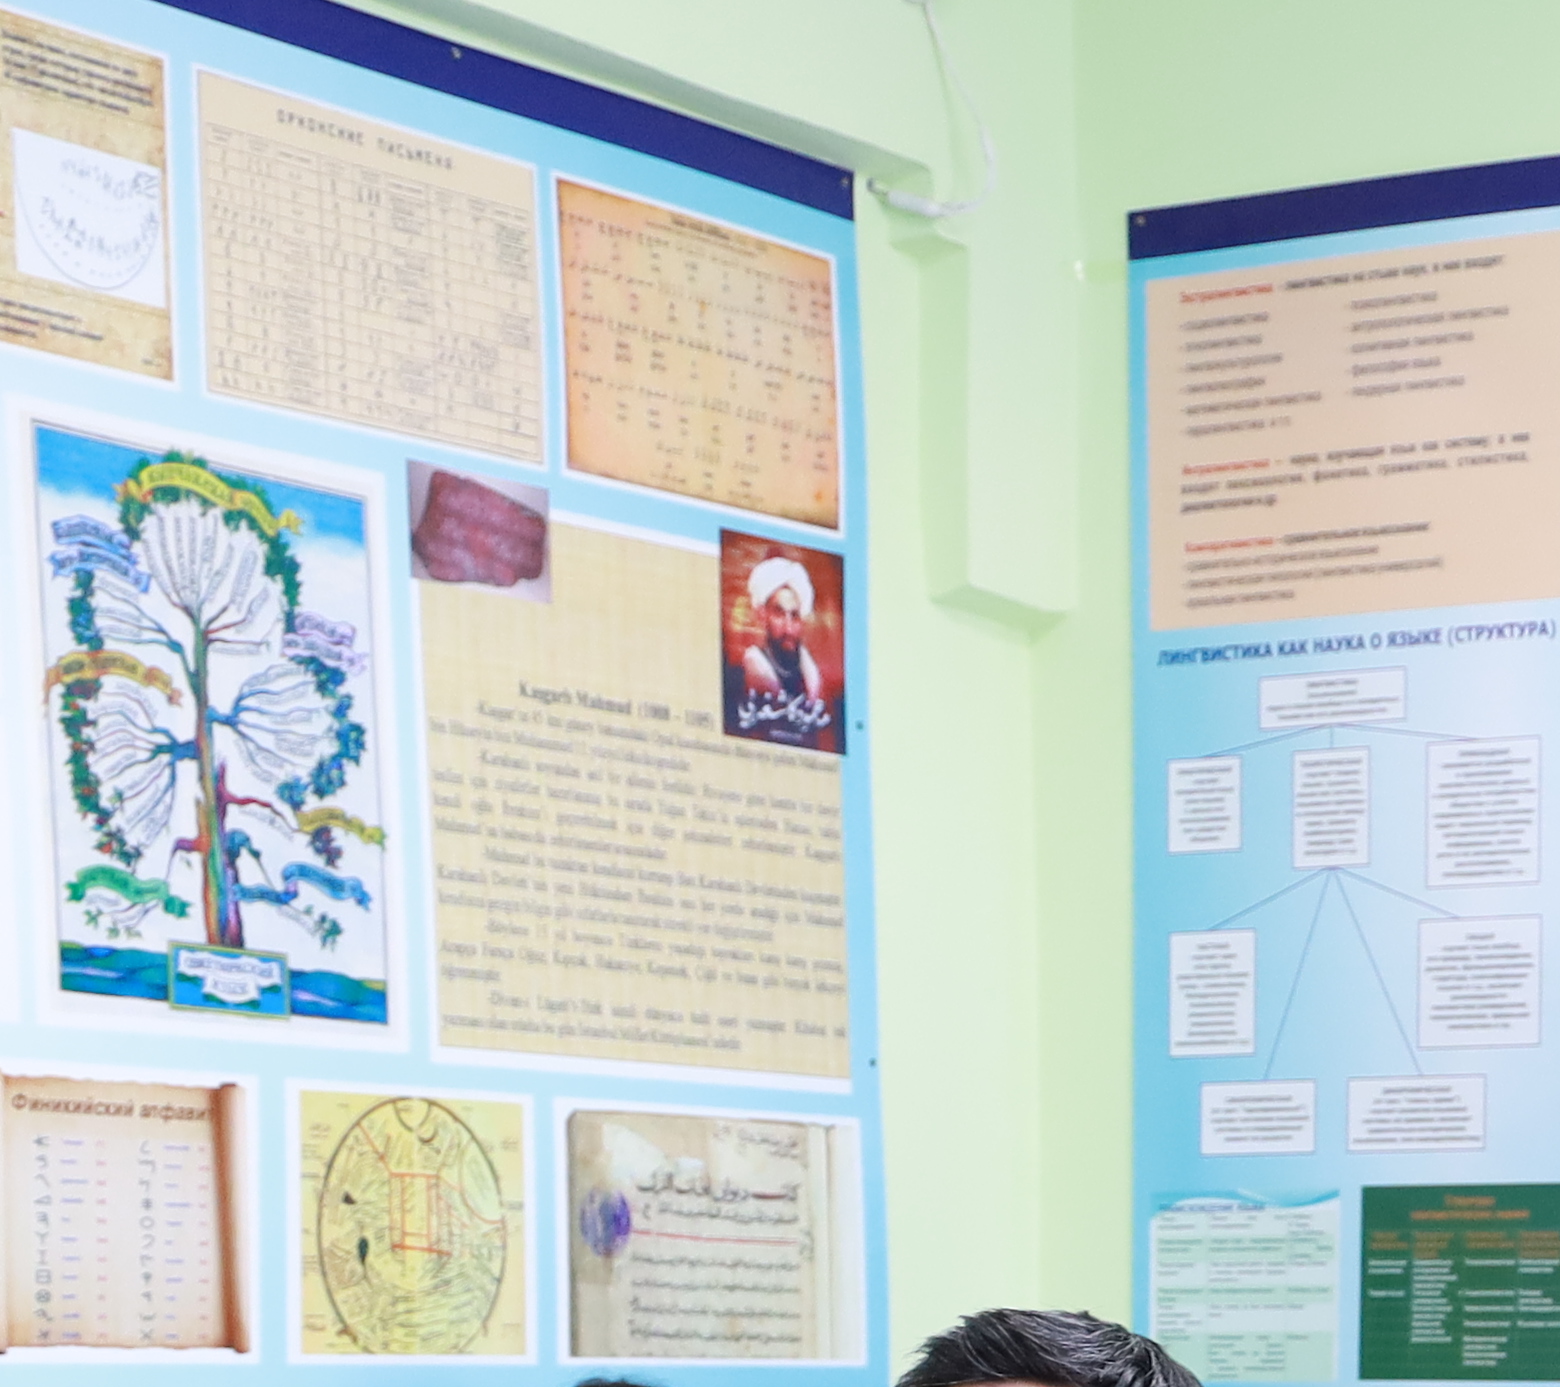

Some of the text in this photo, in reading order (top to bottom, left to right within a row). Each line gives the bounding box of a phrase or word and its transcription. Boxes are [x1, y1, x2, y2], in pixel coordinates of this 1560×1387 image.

[1157, 618, 1556, 668] ЛИНГВИСТИКА КАК НАУКА О ЯЗЫКЕ (СТРУКТУРА)
[11, 1092, 209, 1122] Финикийский алфави
